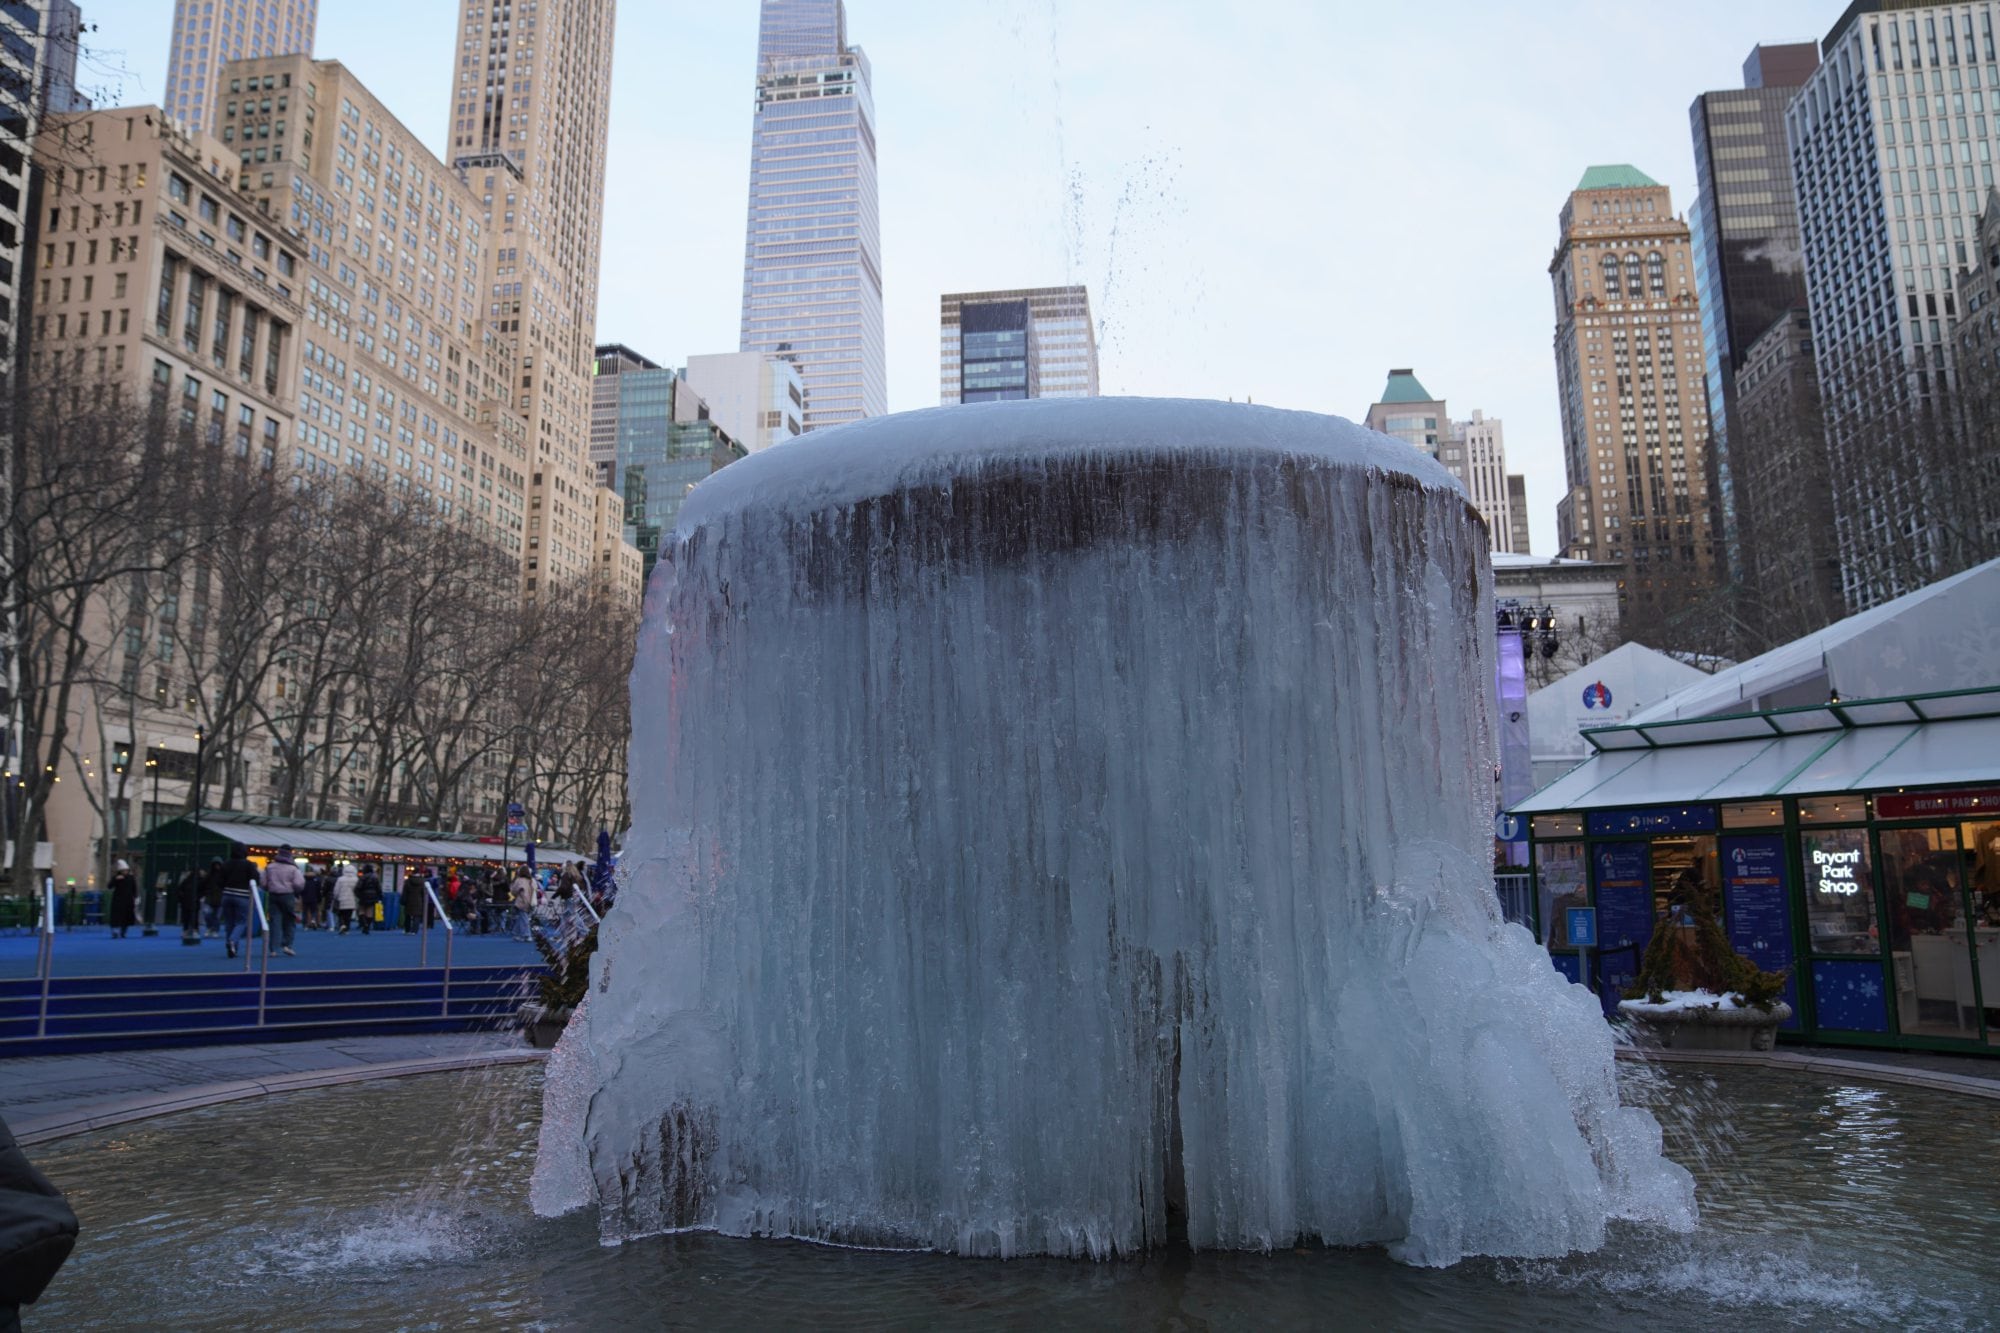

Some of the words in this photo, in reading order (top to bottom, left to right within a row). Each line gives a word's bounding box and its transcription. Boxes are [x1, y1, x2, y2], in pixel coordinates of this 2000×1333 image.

[1981, 796, 2000, 807] SHO
[1813, 849, 1860, 866] Bryant
[1822, 865, 1853, 878] Park
[1819, 879, 1858, 896] Shop
